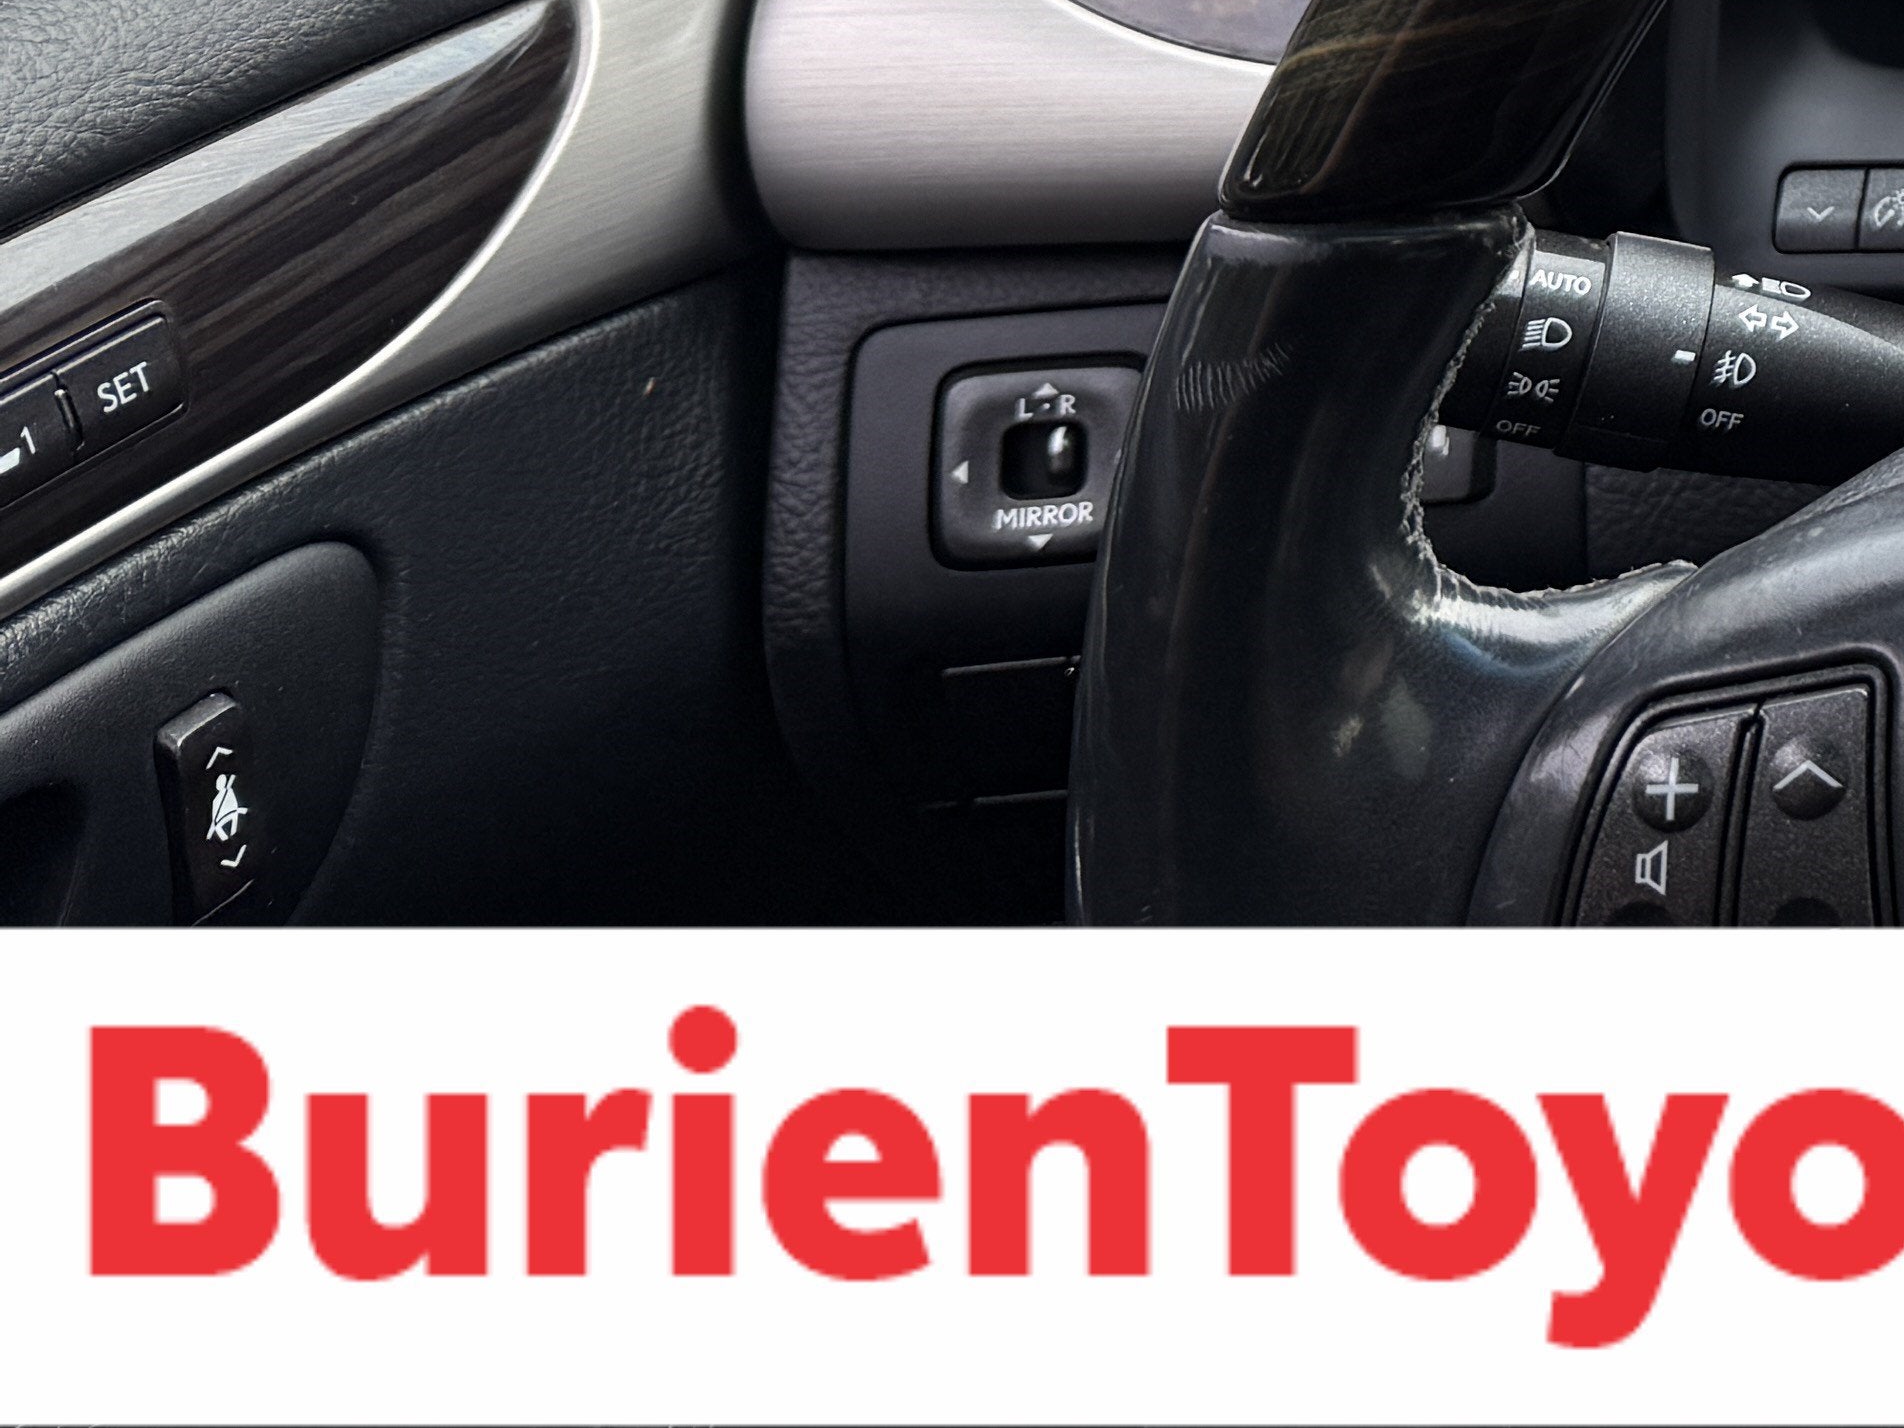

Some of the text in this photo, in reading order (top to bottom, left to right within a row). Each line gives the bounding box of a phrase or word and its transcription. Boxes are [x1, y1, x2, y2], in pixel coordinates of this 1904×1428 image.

[1528, 268, 1592, 296] AUTO
[98, 361, 153, 413] SET
[1015, 394, 1076, 421] L R
[1700, 407, 1745, 432] OFF
[20, 426, 36, 455] 1
[1496, 419, 1541, 438] OFF
[992, 501, 1094, 531] MIRROR
